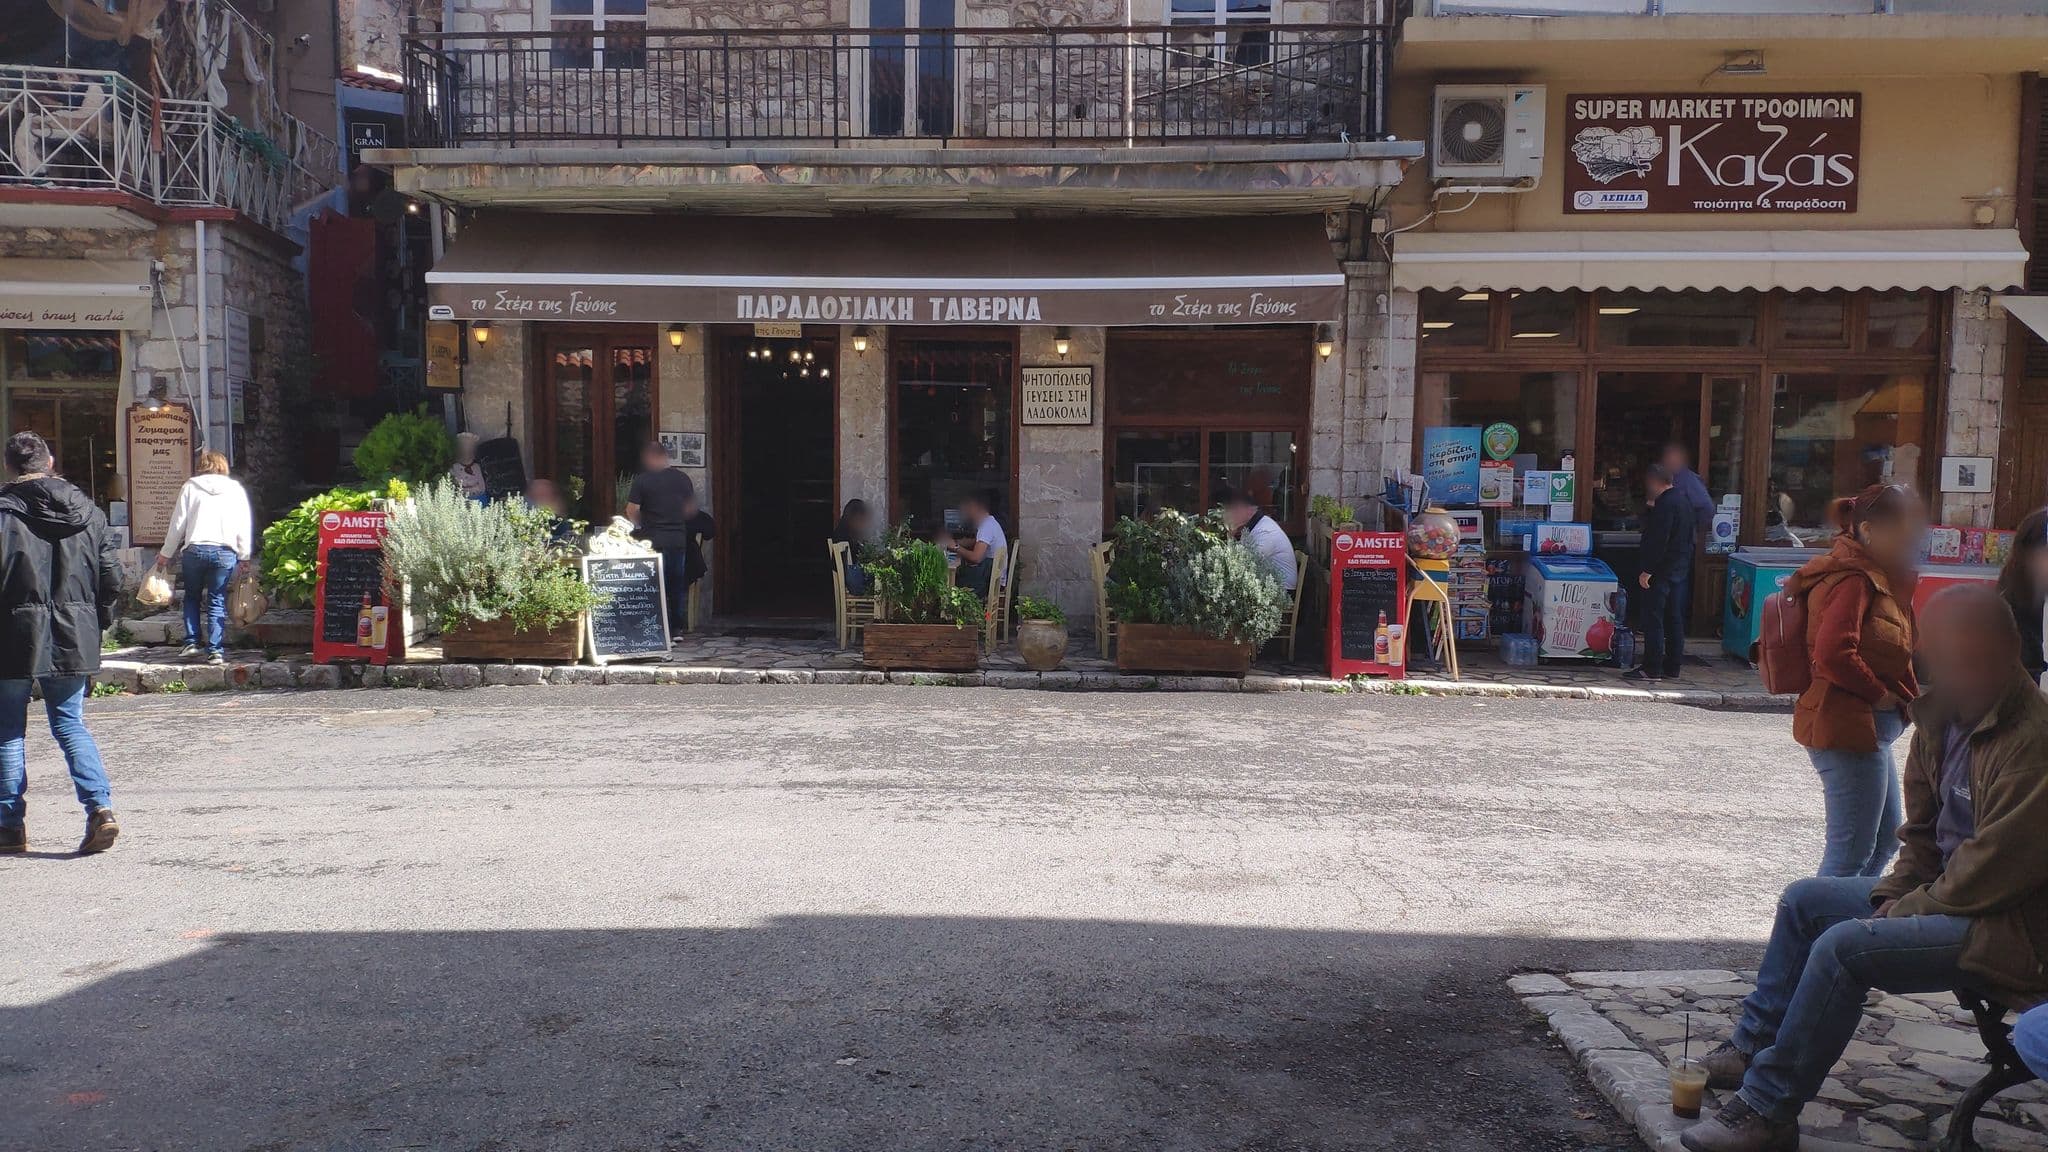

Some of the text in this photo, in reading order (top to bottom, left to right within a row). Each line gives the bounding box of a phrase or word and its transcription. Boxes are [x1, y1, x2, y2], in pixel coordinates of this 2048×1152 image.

[1575, 99, 1642, 119] SUPER
[1650, 99, 1734, 119] MARKET
[1600, 193, 1643, 202] ΑΣΠΙΔΑ
[1693, 196, 1846, 211] ποιότητα & παράδοση
[737, 294, 1042, 321] ΠΑΡΑΔΟΣΙΑΚΗ ΤΑΒΕΡΝΑ
[0, 308, 34, 322] ύσεις
[42, 309, 77, 322] όπως
[1021, 373, 1091, 388] ΨΗΤΟΠΩΛΕΙΟ
[1026, 389, 1088, 403] ΓΕΥΣΕΙΣ ΣΤΗ
[1026, 406, 1088, 420] ΛΑΔΟΚΟΛΛΑ
[342, 517, 385, 528] AMSTE
[1354, 537, 1402, 549] AMSTEL
[1560, 582, 1589, 606] 100%
